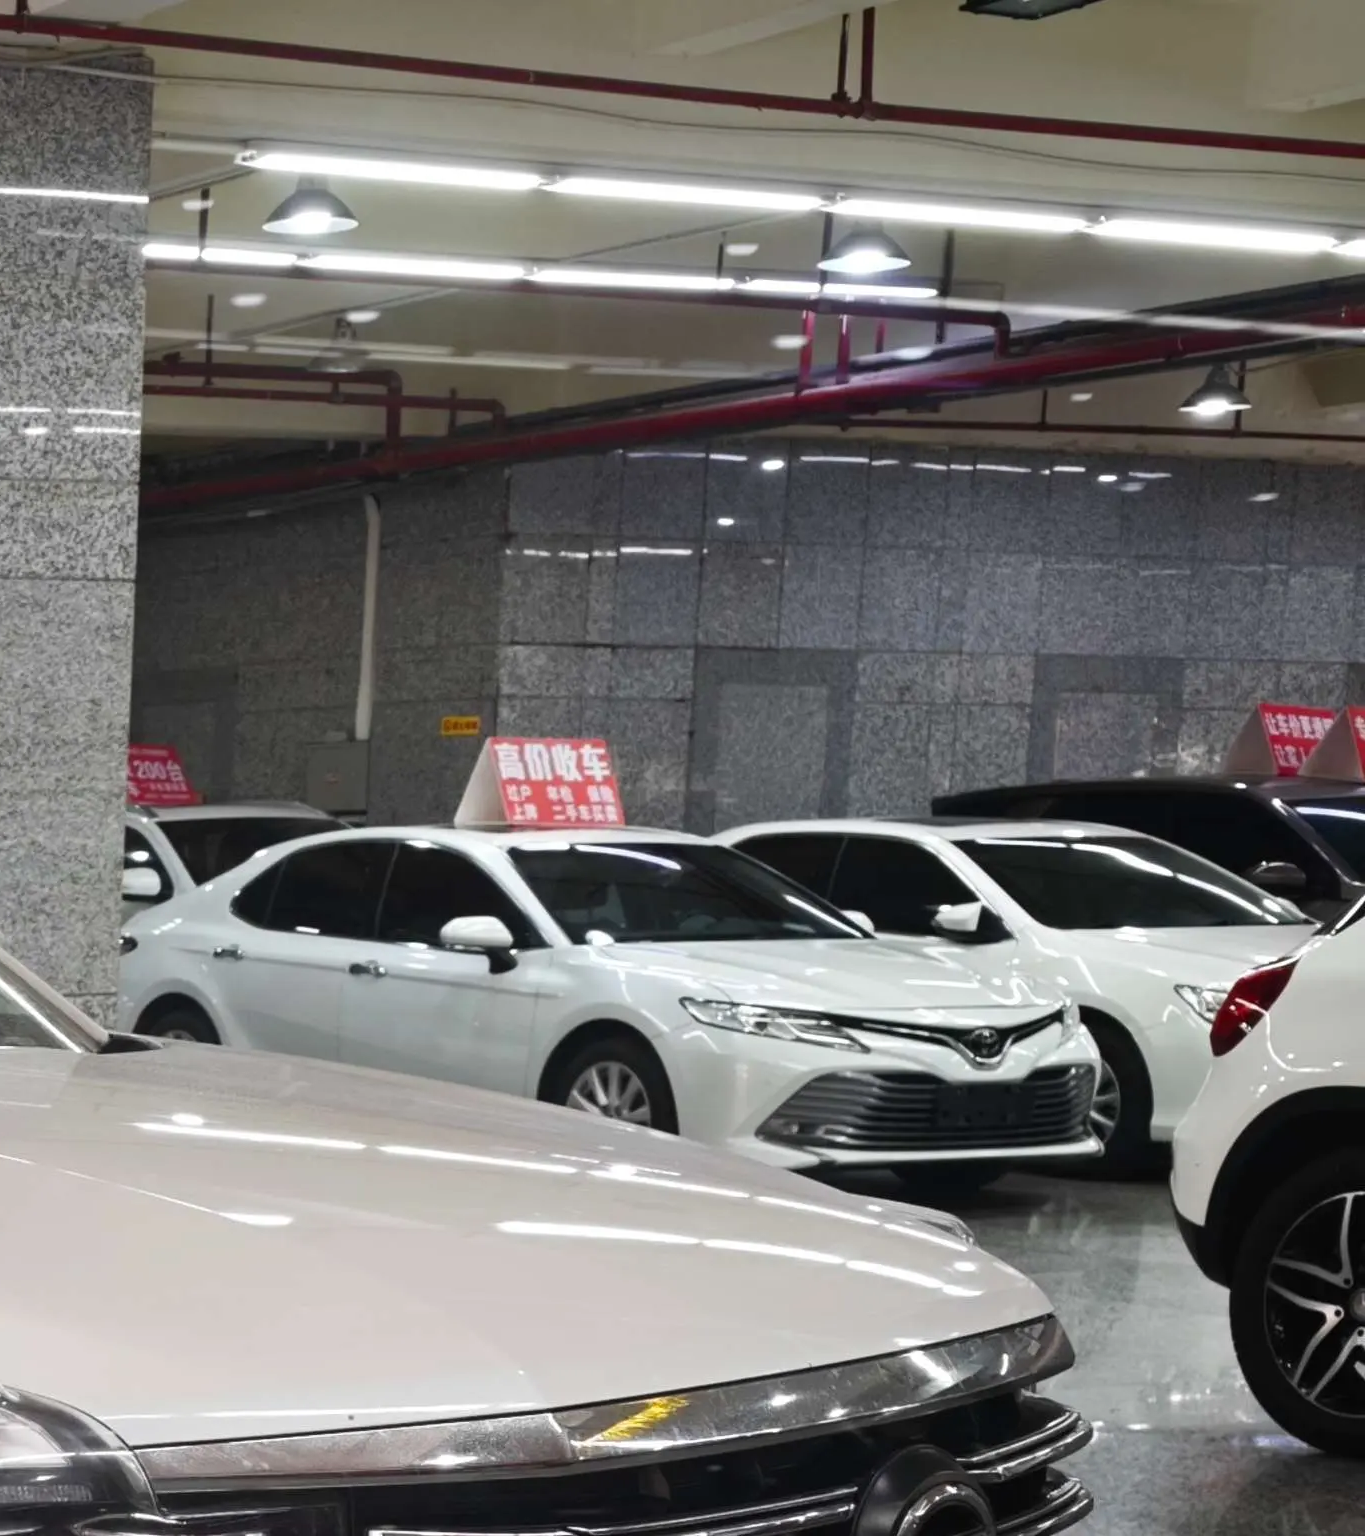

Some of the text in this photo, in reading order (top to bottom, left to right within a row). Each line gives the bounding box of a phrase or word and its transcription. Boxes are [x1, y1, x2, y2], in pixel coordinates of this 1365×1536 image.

[128, 760, 185, 780] 200台
[493, 743, 611, 782] 高价收车
[505, 784, 532, 801] 过户
